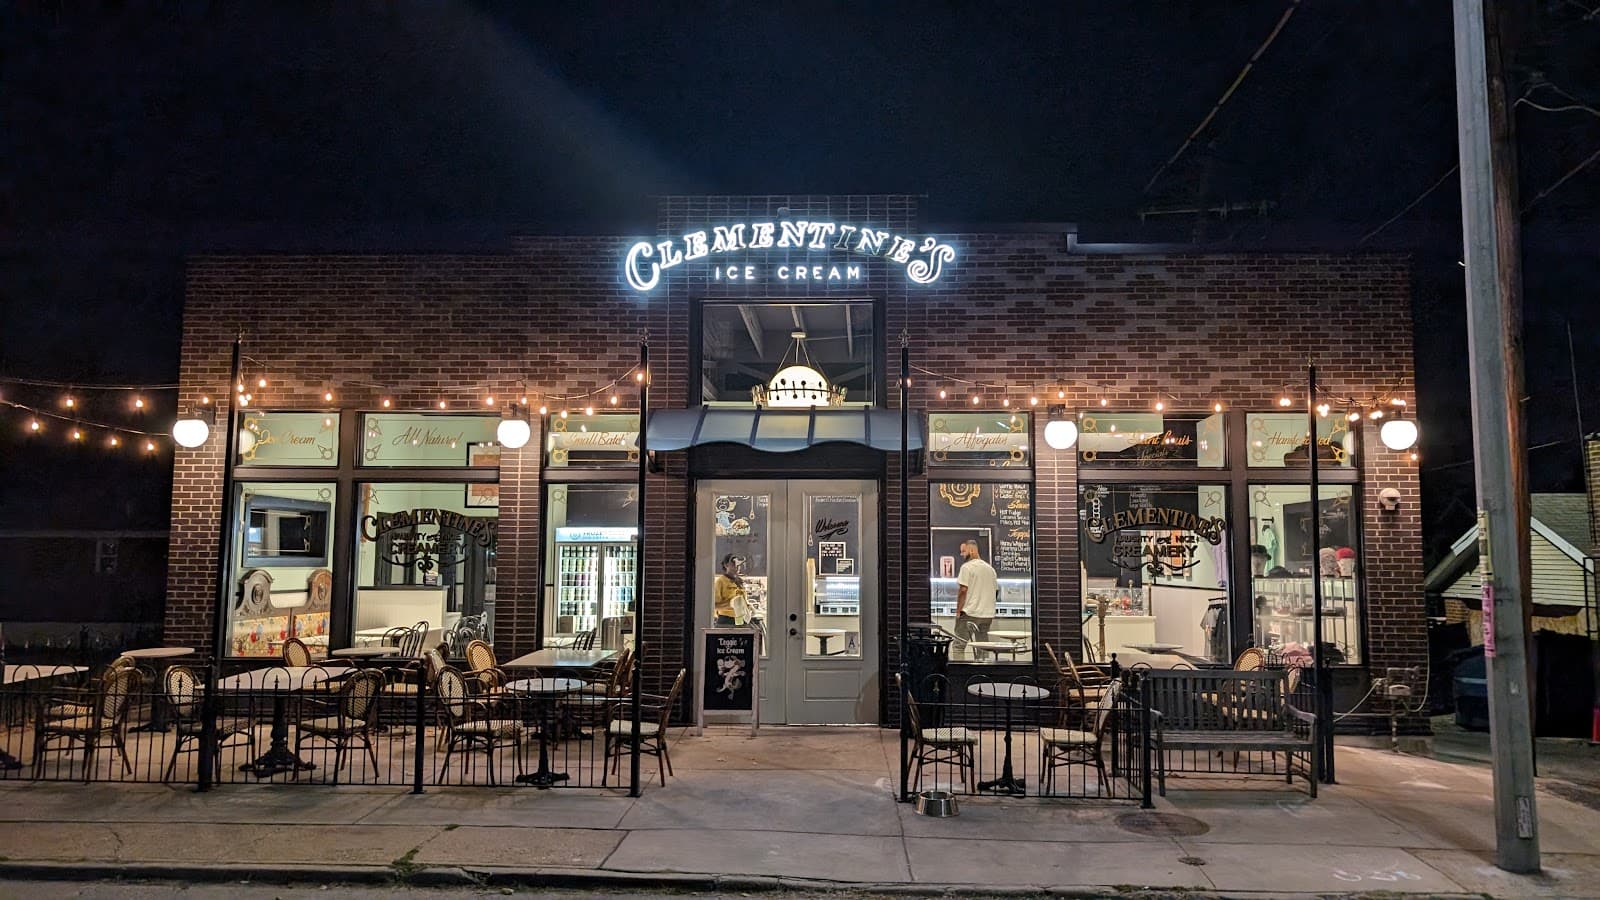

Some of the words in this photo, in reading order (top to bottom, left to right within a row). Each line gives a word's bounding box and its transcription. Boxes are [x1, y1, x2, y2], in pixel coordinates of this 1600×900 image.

[625, 221, 955, 291] CLEMENTINE'S
[715, 266, 755, 280] ICE
[777, 266, 861, 280] CREAM
[392, 426, 421, 445] All
[418, 427, 464, 447] Natural
[953, 431, 1008, 449] Affogatos
[815, 517, 849, 534] Welcome
[1084, 507, 1226, 547] CLEMENTINE'S
[1116, 535, 1153, 544] NAUGHTY
[1175, 535, 1195, 544] NICE
[390, 543, 467, 555] CREAMERY
[1112, 545, 1198, 558] CREAMERY
[726, 647, 745, 655] Cream
